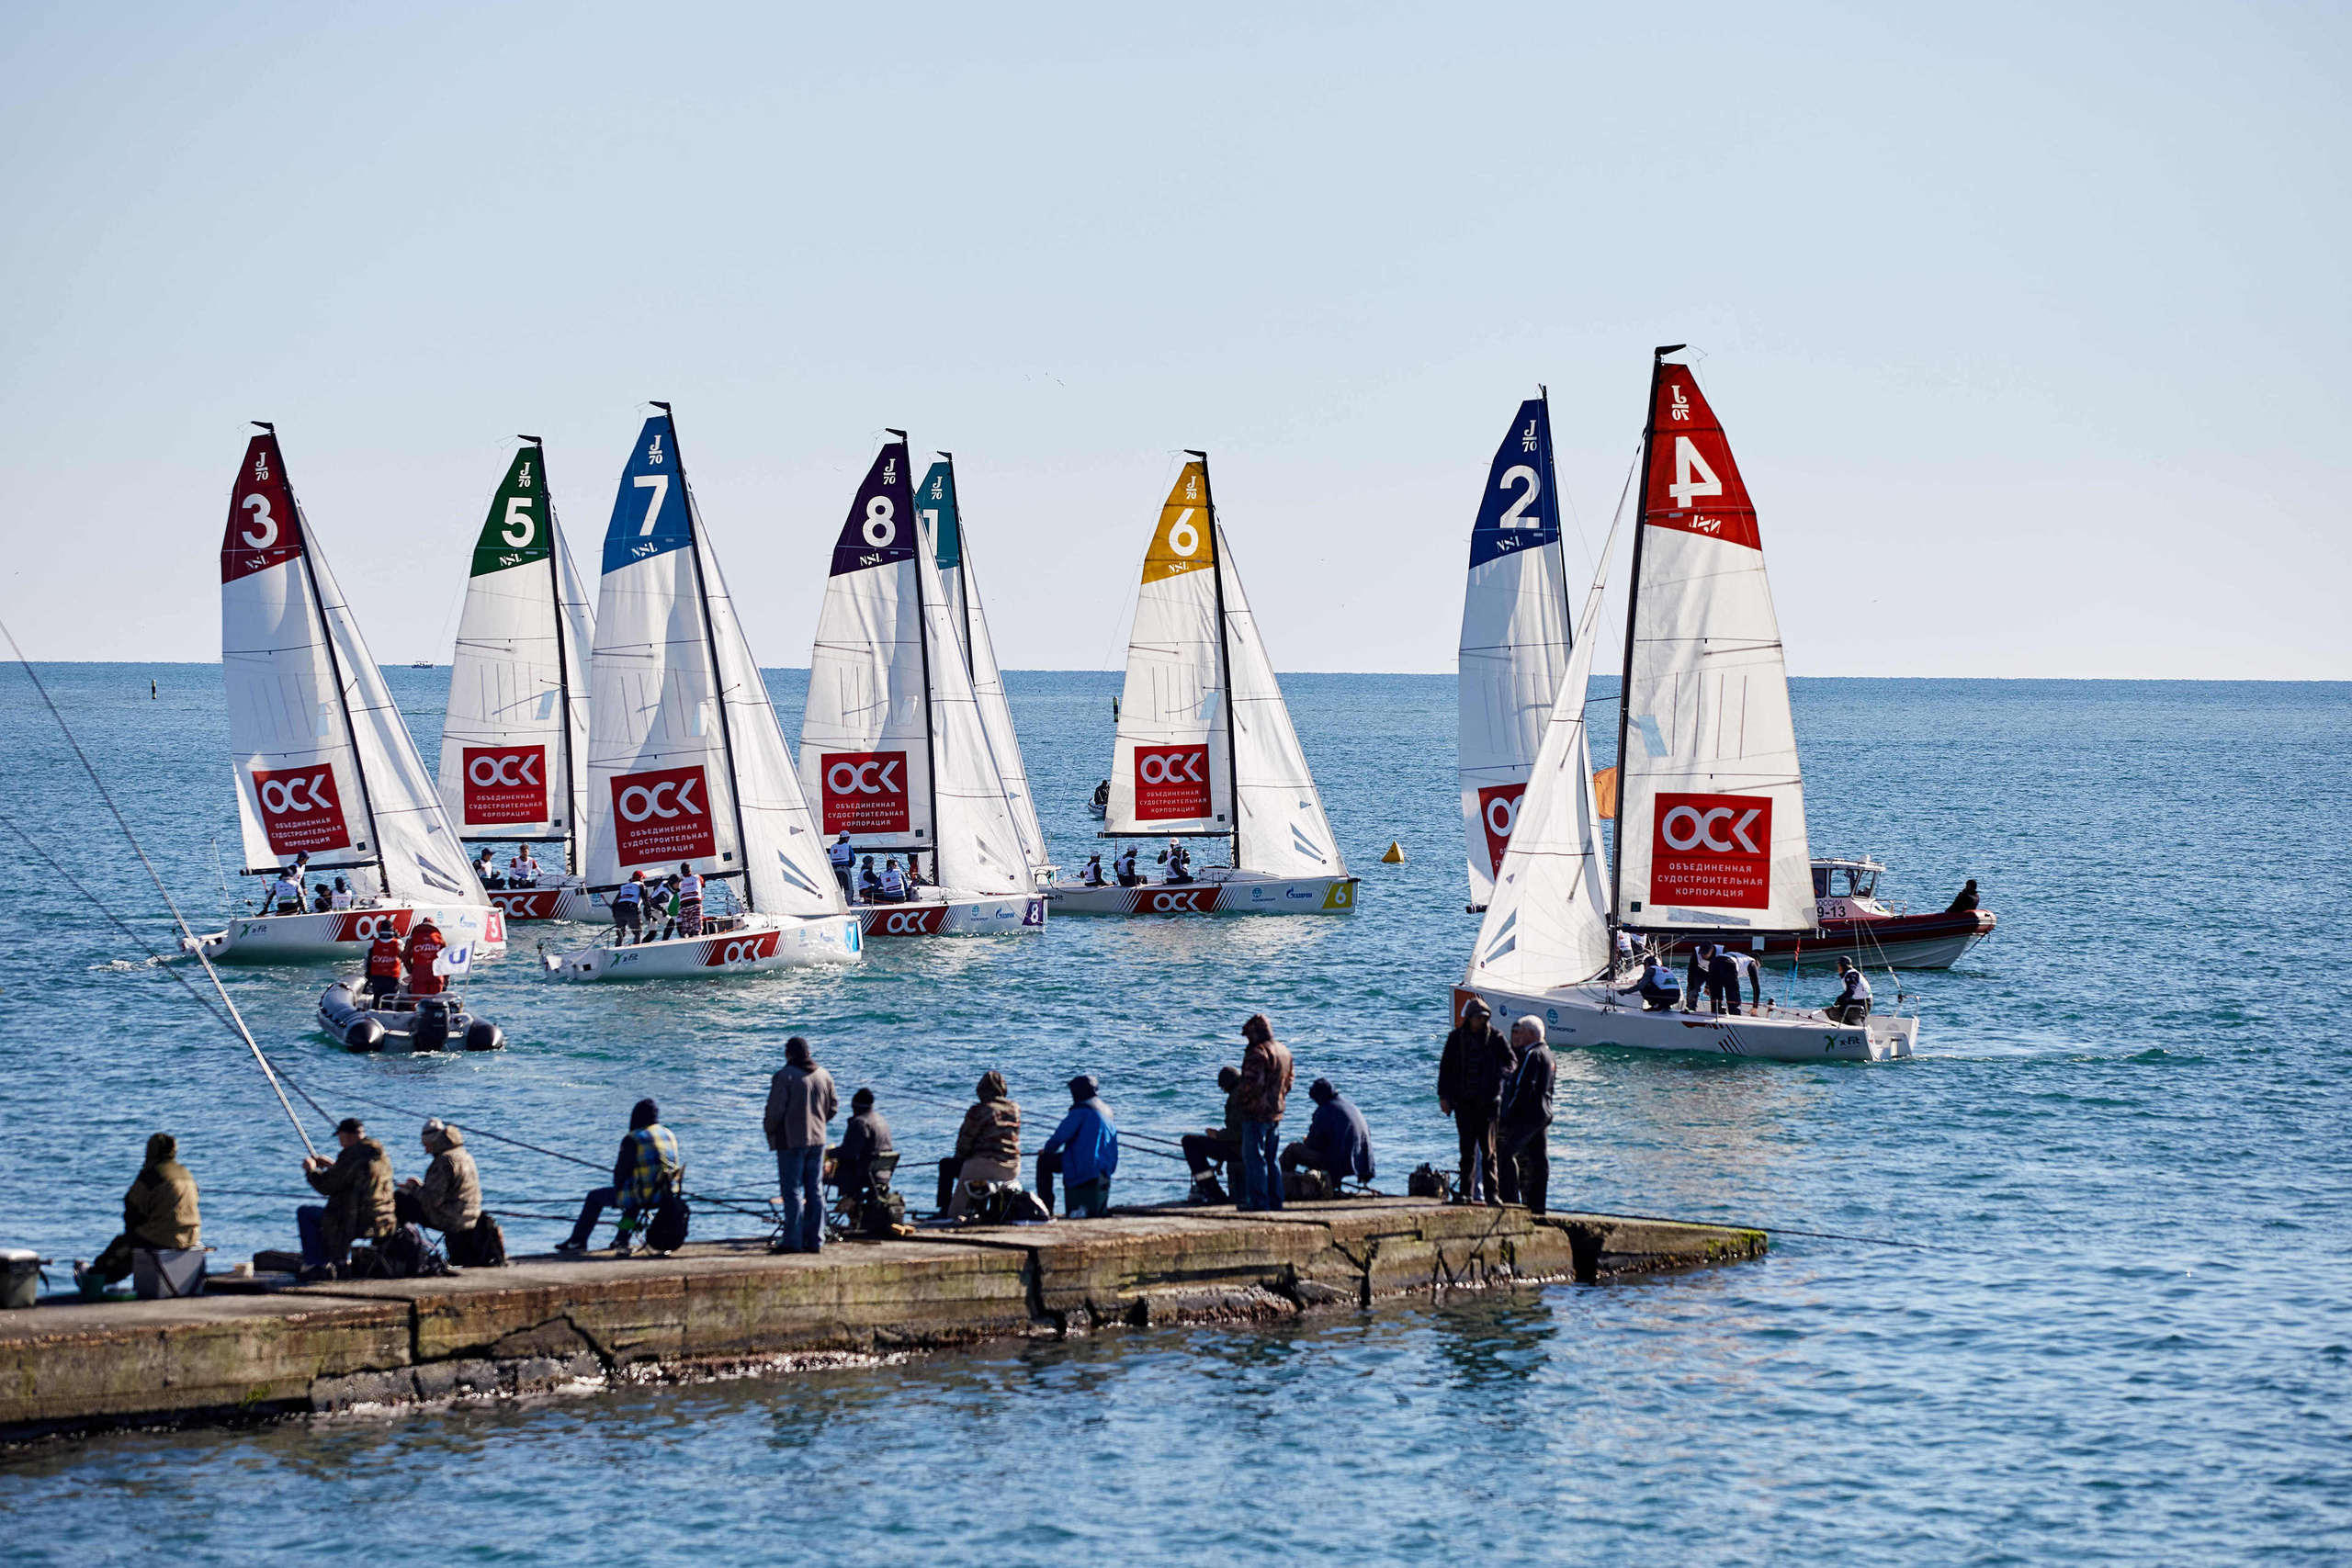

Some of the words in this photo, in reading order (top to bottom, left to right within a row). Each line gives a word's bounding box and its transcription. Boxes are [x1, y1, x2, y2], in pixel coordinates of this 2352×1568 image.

[1523, 419, 1537, 437] J
[650, 434, 662, 451] J
[1521, 441, 1537, 453] 70
[255, 452, 266, 468] J
[649, 454, 663, 465] 70
[884, 458, 896, 472] J
[255, 471, 269, 481] 70
[520, 462, 531, 476] J
[518, 479, 531, 488] 70
[883, 476, 896, 485] 70
[933, 476, 944, 489] J
[1187, 476, 1197, 489] J
[931, 491, 943, 500] 70
[1186, 491, 1197, 500] 70
[1499, 464, 1541, 529] 2
[633, 475, 668, 536] 7
[242, 493, 278, 549] 3
[502, 497, 535, 548] 5
[862, 495, 896, 547] 8
[922, 509, 939, 557] 1
[1169, 508, 1199, 557] 6
[469, 754, 540, 787] ОСК
[1140, 752, 1204, 784] ОСК
[827, 761, 901, 795] ОСК
[261, 773, 334, 815] ОСК
[476, 794, 536, 802] ОБЪЕДИНЕННАЯ
[619, 777, 704, 823] ОСК
[1139, 797, 1207, 806] СУДОСТРОИТЕЛЬНАЯ
[469, 801, 543, 810] СУДОСТРОИТЕЛЬНАЯ
[835, 801, 896, 809] ОБЪЕДИНЕННАЯ
[828, 810, 905, 819] СУДОСТРОИТЕЛЬНАЯ
[629, 823, 698, 838] ОБЪЕДИНЕННАЯ
[1662, 805, 1762, 853] ОСК
[622, 831, 708, 849] СУДОСТРОИТЕЛЬНАЯ
[639, 843, 695, 856] КОРПОРАЦИЯ
[1668, 863, 1752, 873] ОБЪЕДИНЕННАЯ
[1657, 874, 1763, 886] СУДОСТРОИТЕЛЬНАЯ
[1335, 886, 1346, 905] 6
[1675, 887, 1744, 897] КОРПОРАЦИЯ
[1153, 892, 1201, 912] ОСК
[1031, 904, 1039, 923] 8
[1816, 906, 1846, 918] 9-13
[489, 917, 499, 938] 3
[887, 911, 931, 933] ОСК
[724, 937, 765, 964] ОСК
